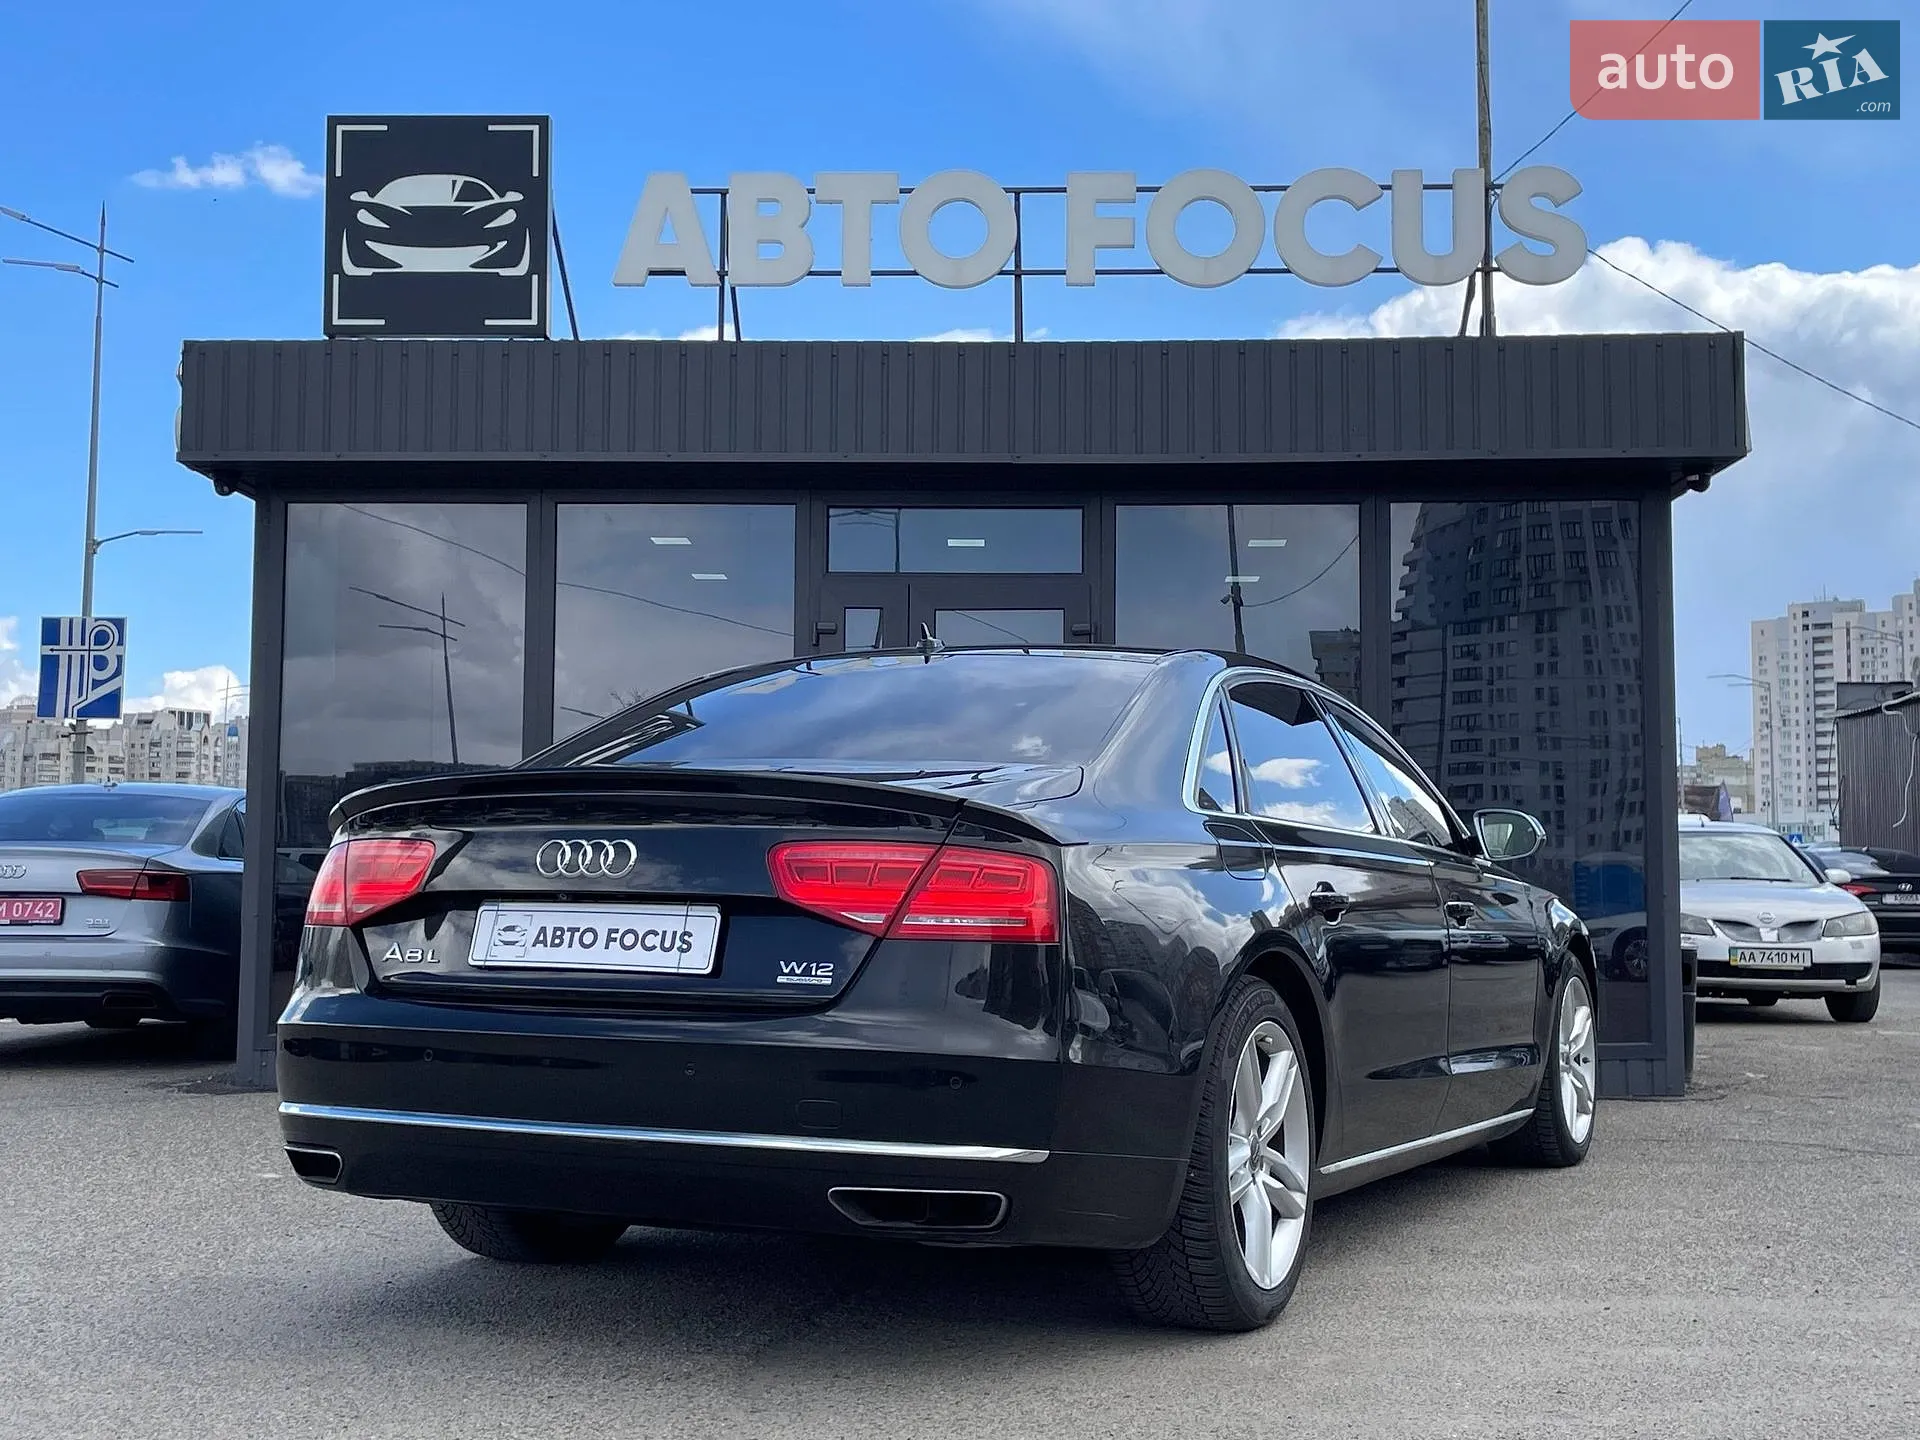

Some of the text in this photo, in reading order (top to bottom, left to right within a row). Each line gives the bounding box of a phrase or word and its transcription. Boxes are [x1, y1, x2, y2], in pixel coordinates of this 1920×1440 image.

[613, 165, 1588, 289] АВТО FOCUS
[13, 902, 54, 917] 0742
[532, 926, 693, 953] АВТО FOCUS
[382, 942, 440, 963] A8L
[1739, 951, 1756, 963] AA
[1760, 952, 1788, 964] 7410
[780, 961, 834, 976] W12
